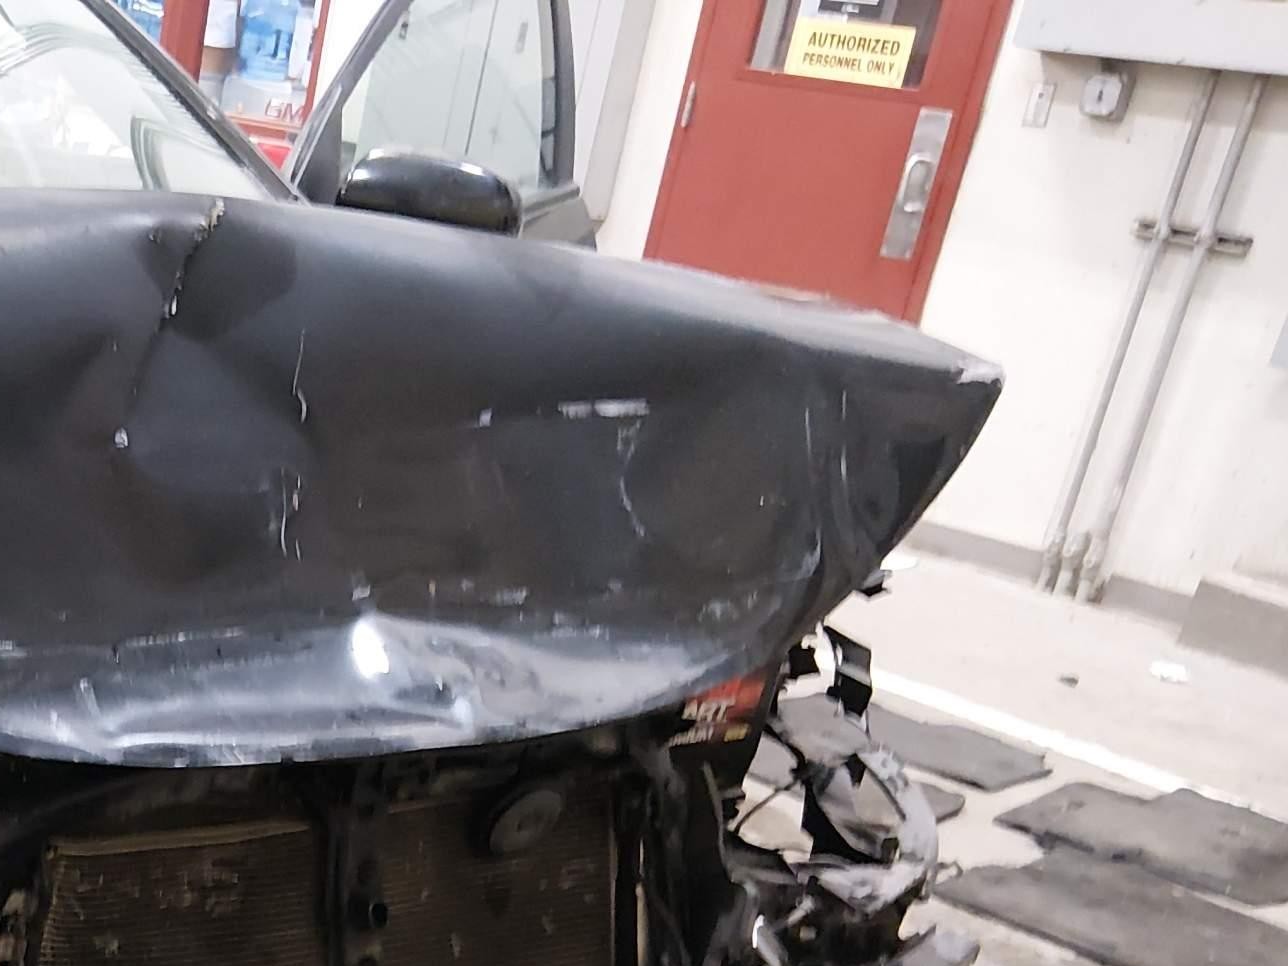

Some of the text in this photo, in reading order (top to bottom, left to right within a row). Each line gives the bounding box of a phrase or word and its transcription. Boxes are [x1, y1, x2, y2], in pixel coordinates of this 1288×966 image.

[807, 31, 901, 57] AUTHORIZED
[802, 52, 895, 75] PERSONNEL ONLY
